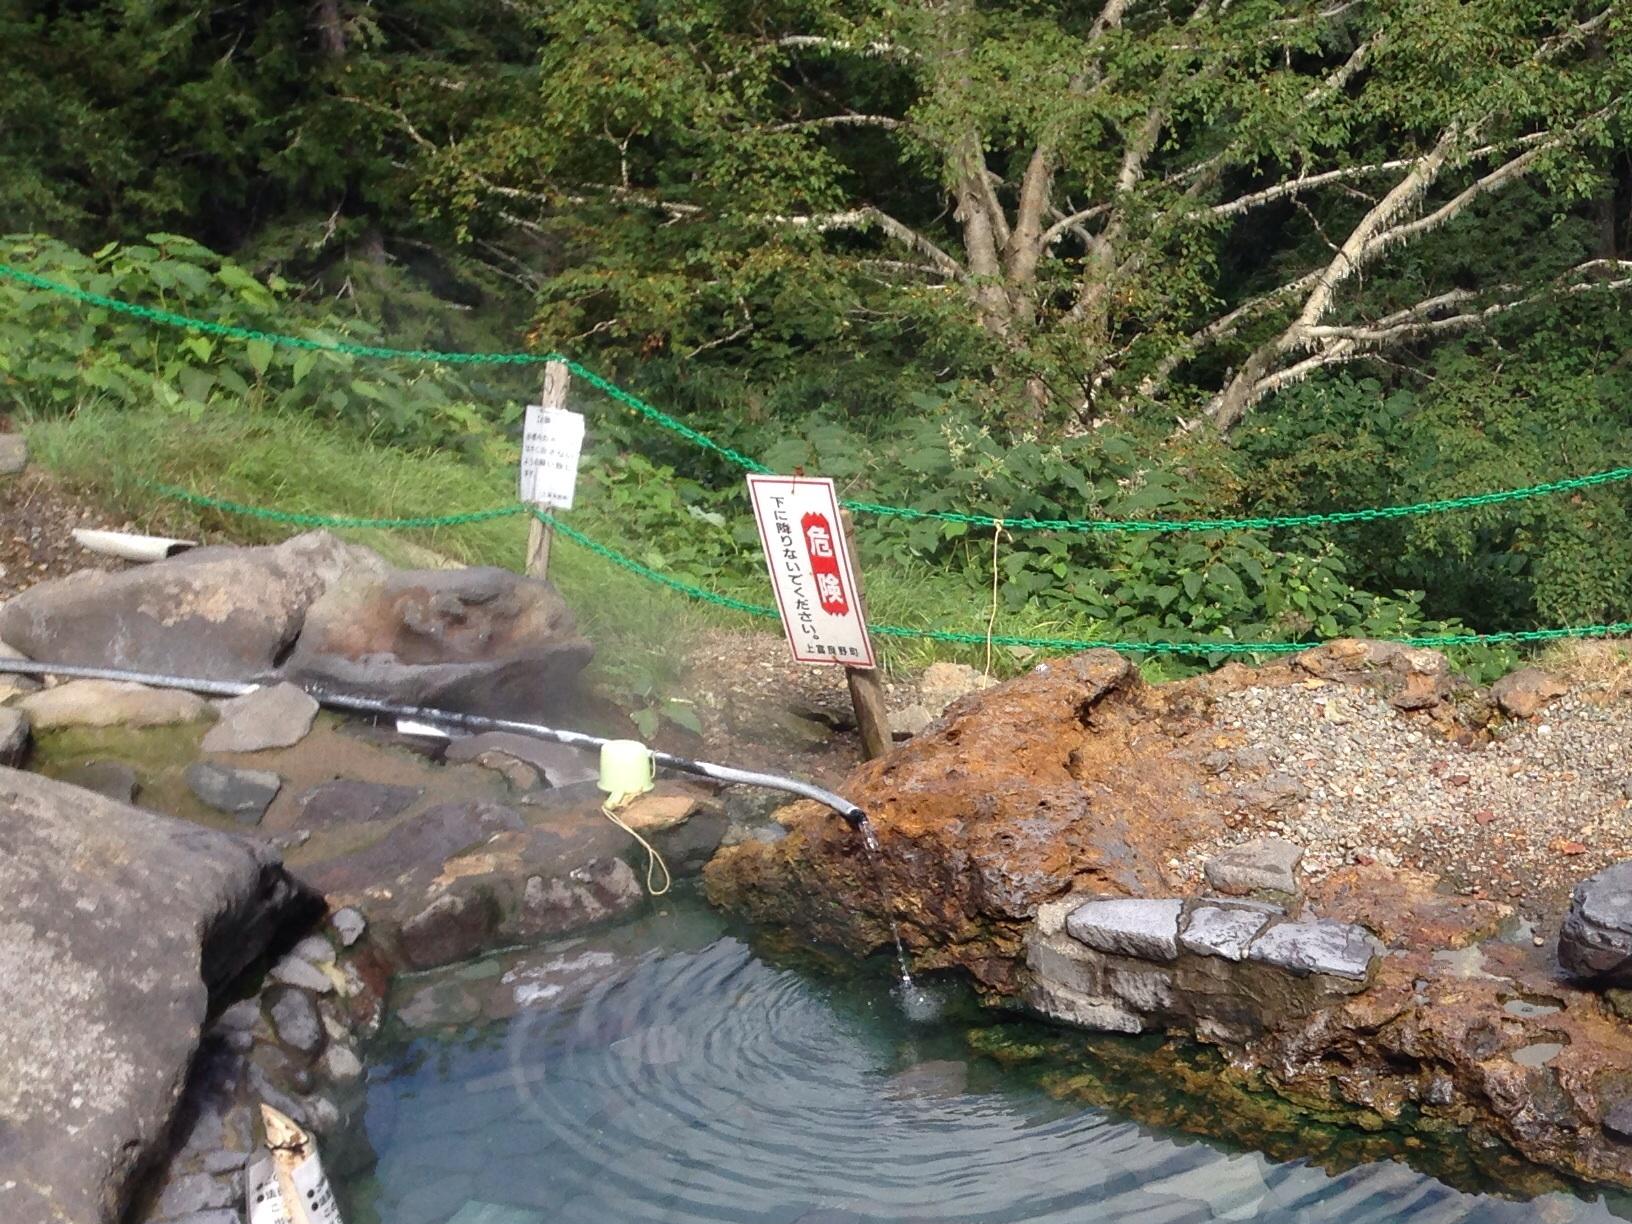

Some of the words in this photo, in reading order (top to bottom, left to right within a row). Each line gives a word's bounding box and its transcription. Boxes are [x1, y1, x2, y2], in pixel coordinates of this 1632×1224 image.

[770, 495, 820, 641] 下に降りないでください。
[806, 525, 844, 604] 危険
[806, 642, 859, 658] 上富良野町
